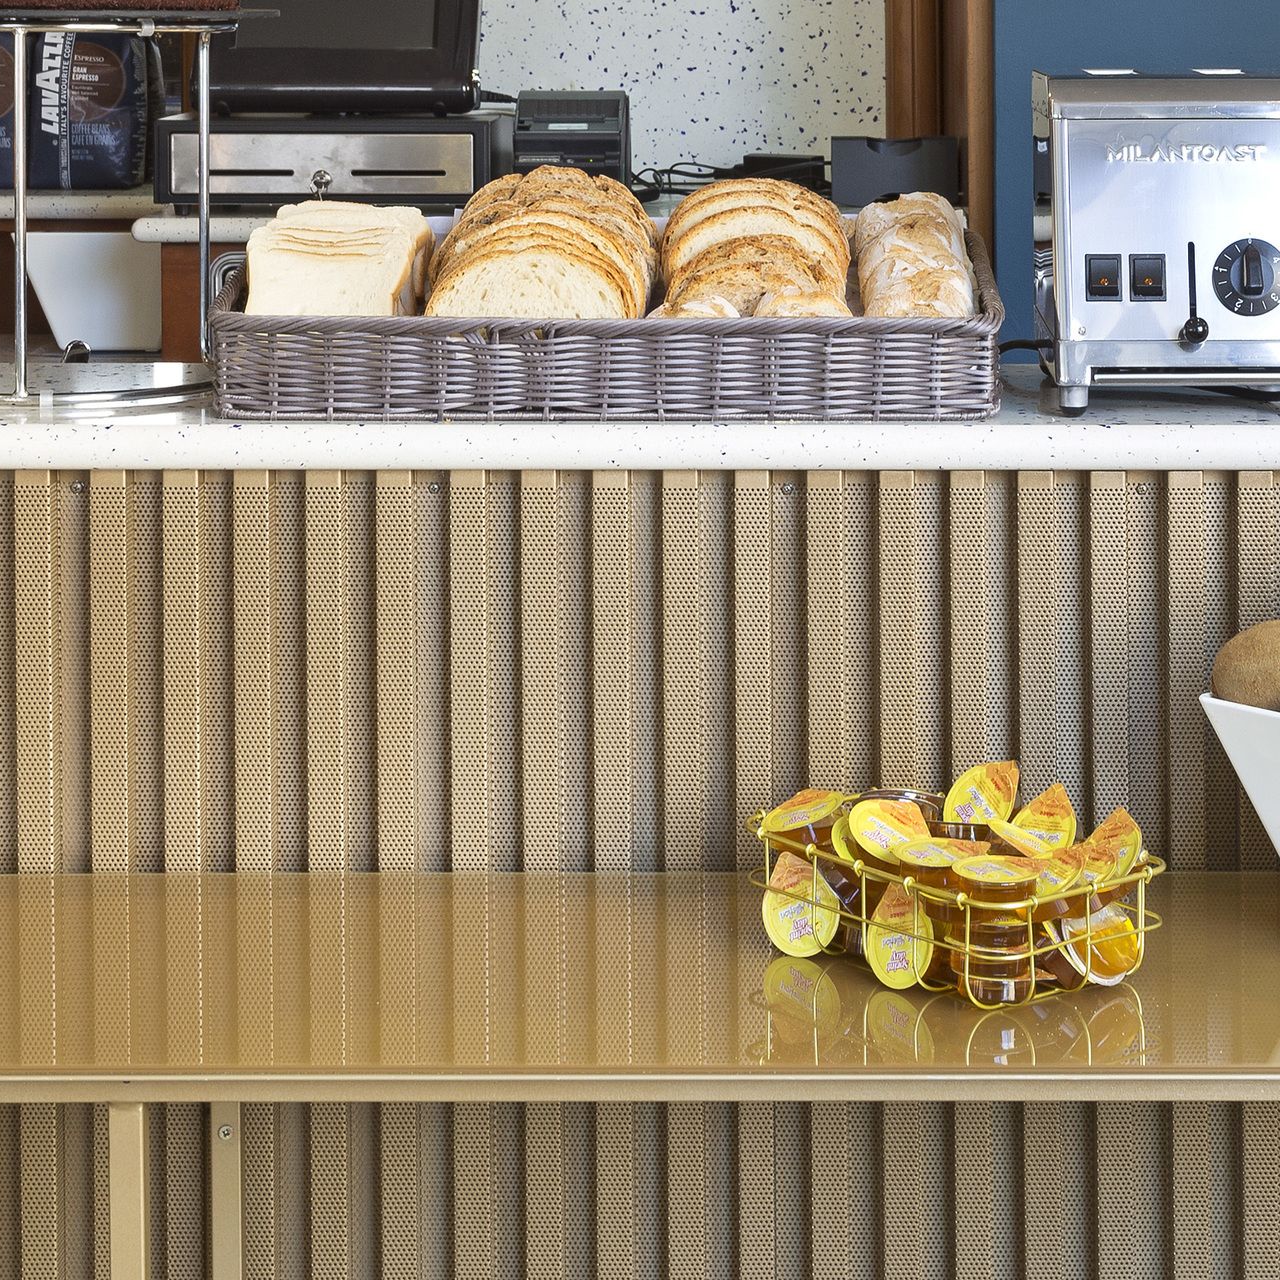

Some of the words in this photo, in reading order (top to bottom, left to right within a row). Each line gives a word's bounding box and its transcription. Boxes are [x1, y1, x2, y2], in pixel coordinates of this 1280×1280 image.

[36, 32, 65, 135] LAVAZZA
[61, 61, 69, 105] FAVOURITE
[1105, 143, 1268, 162] MILANTOAST
[1236, 298, 1243, 308] 2
[1271, 293, 1278, 301] 3
[792, 917, 808, 930] day
[789, 925, 813, 941] Sprint
[891, 950, 906, 961] day
[887, 959, 909, 973] Sprint
